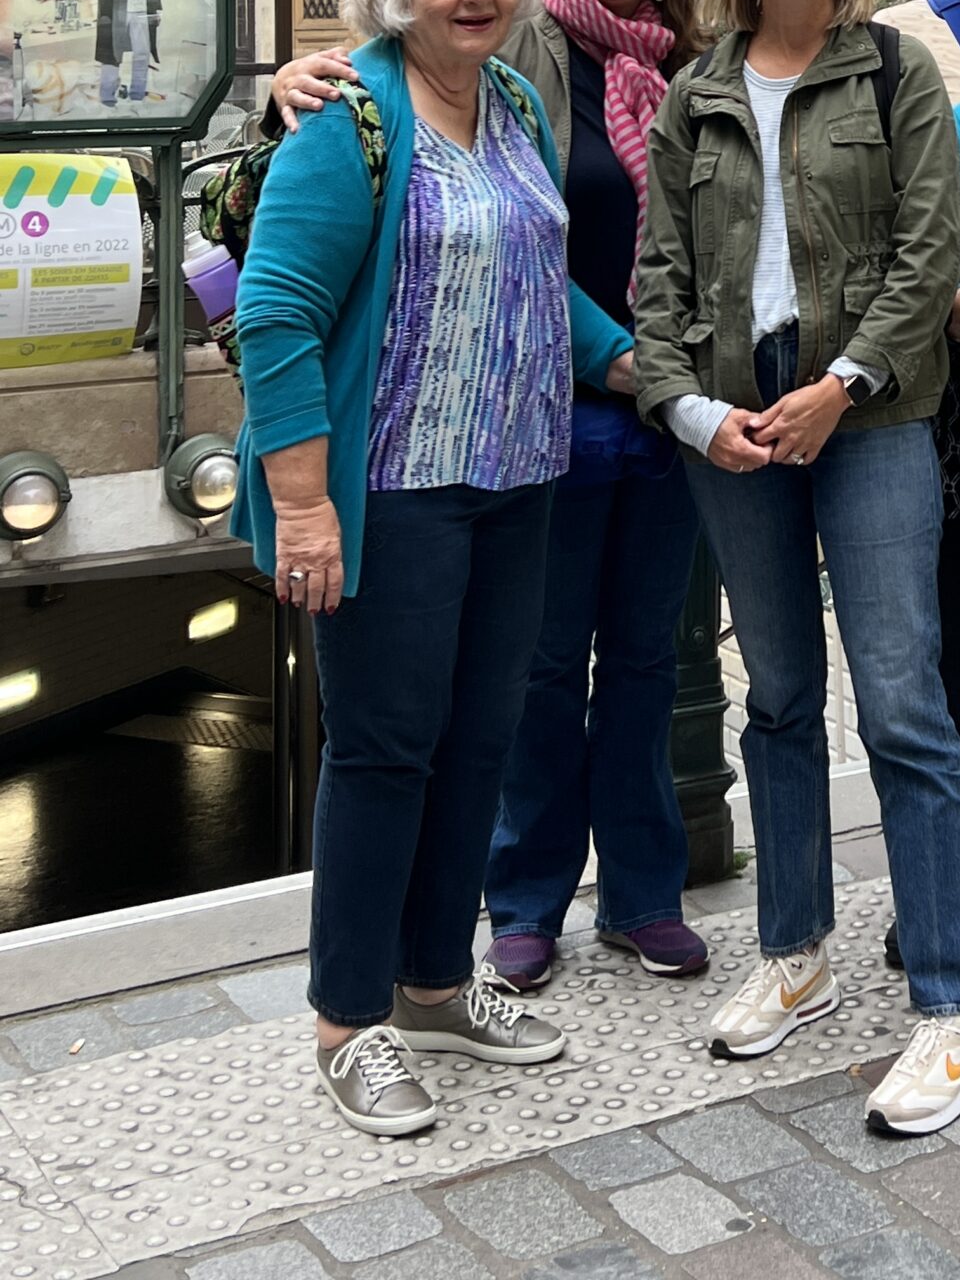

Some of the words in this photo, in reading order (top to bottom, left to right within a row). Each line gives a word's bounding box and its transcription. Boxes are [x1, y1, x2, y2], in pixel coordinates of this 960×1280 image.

[27, 215, 42, 233] 4
[18, 243, 30, 256] la
[35, 241, 69, 258] ligne
[73, 242, 91, 253] en
[95, 238, 130, 252] 2022
